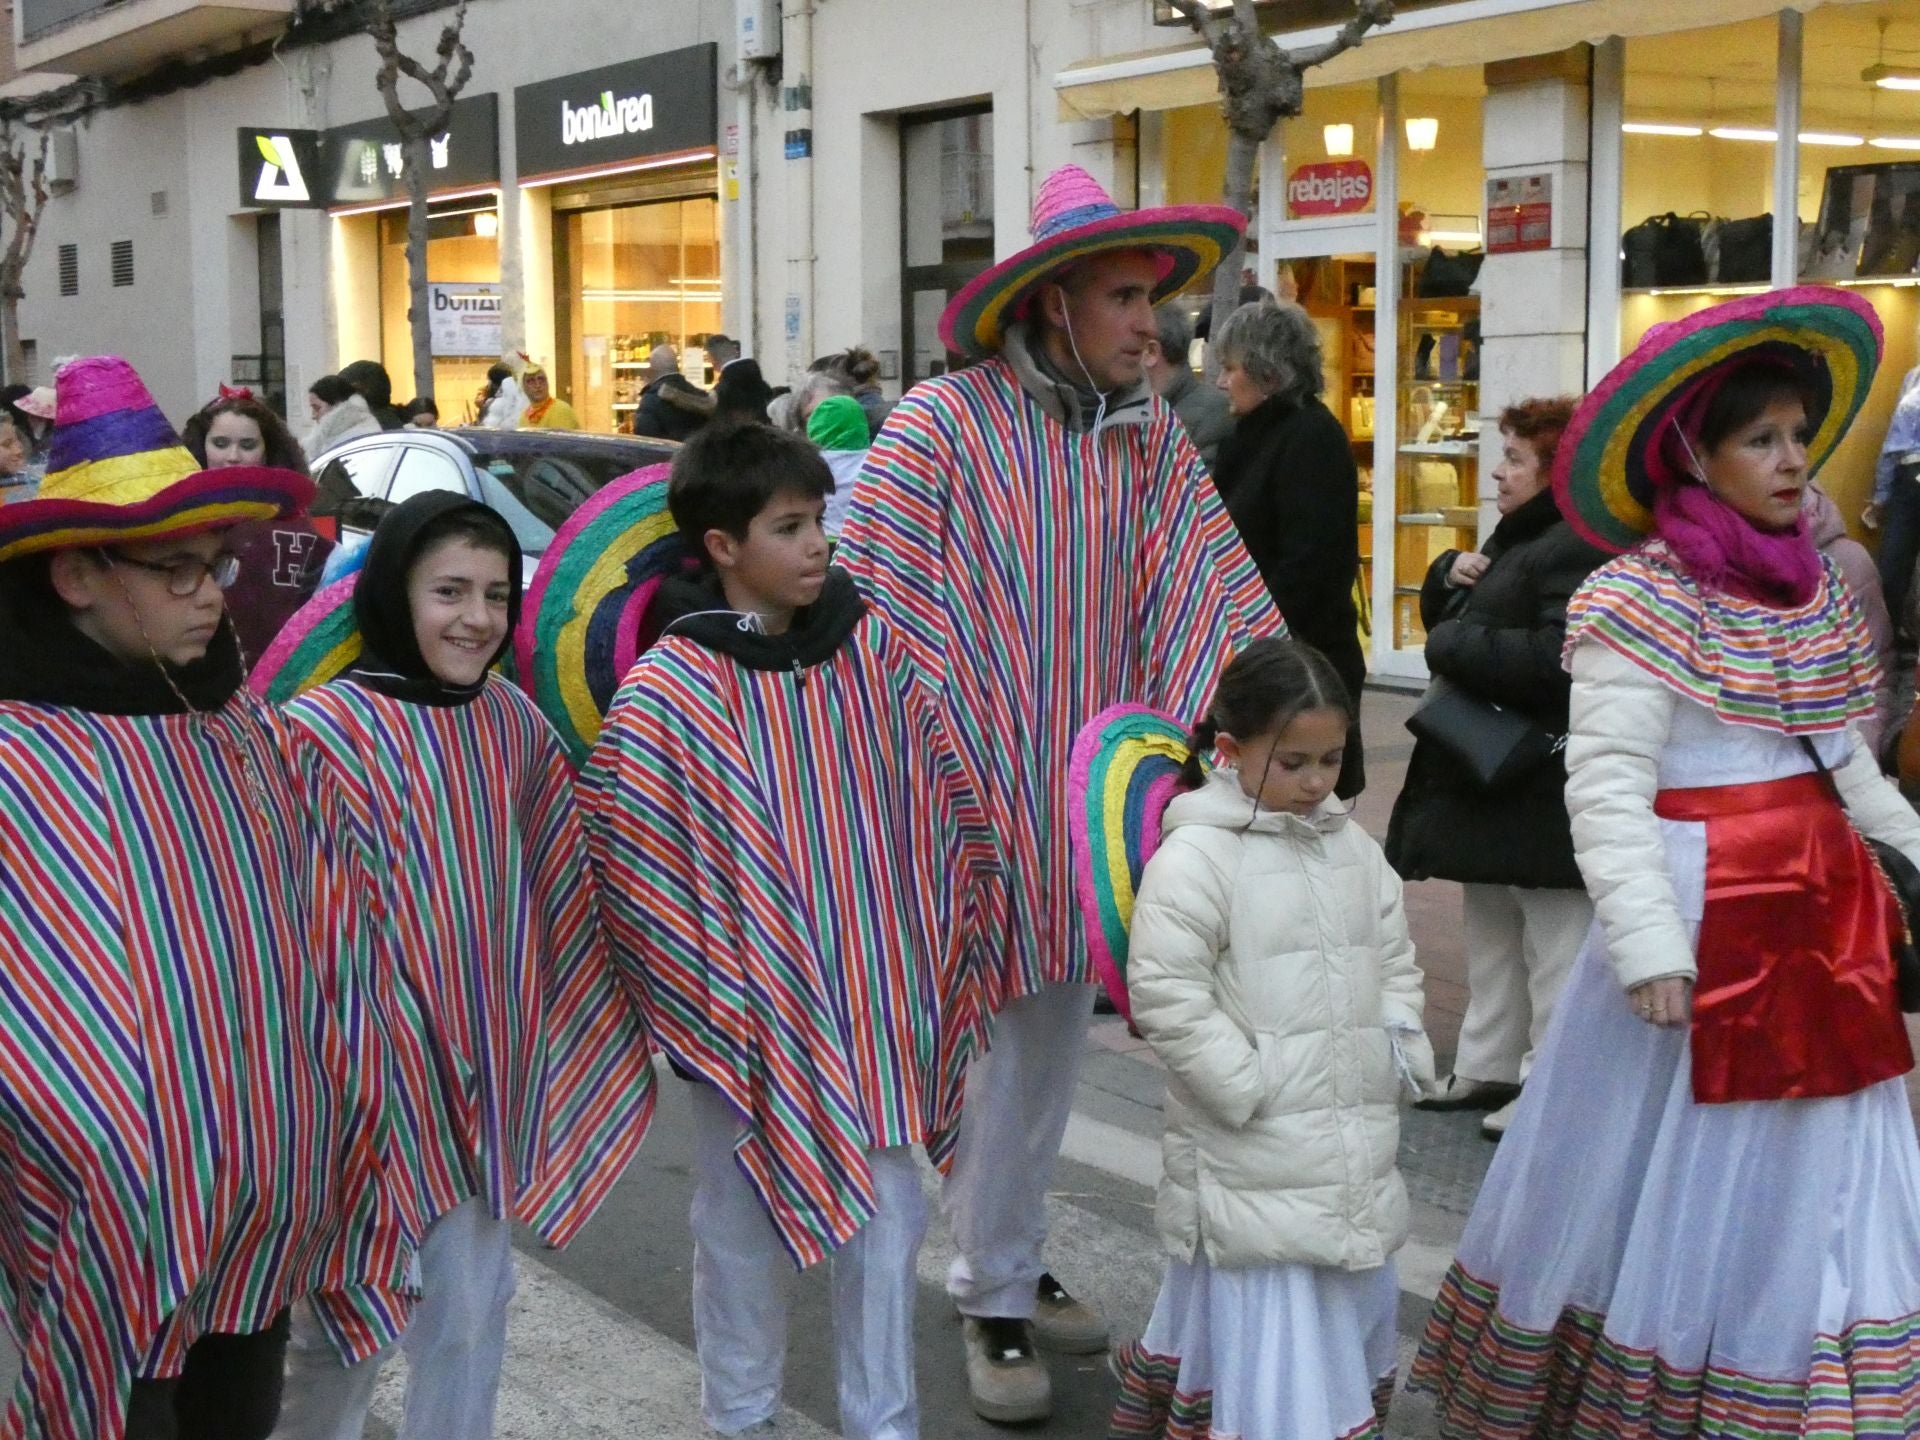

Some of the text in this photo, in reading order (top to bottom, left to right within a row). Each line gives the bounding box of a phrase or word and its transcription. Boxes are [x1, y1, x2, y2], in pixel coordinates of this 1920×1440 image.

[562, 90, 653, 145] bonArea
[1288, 169, 1369, 208] rebajas
[272, 530, 317, 587] H
